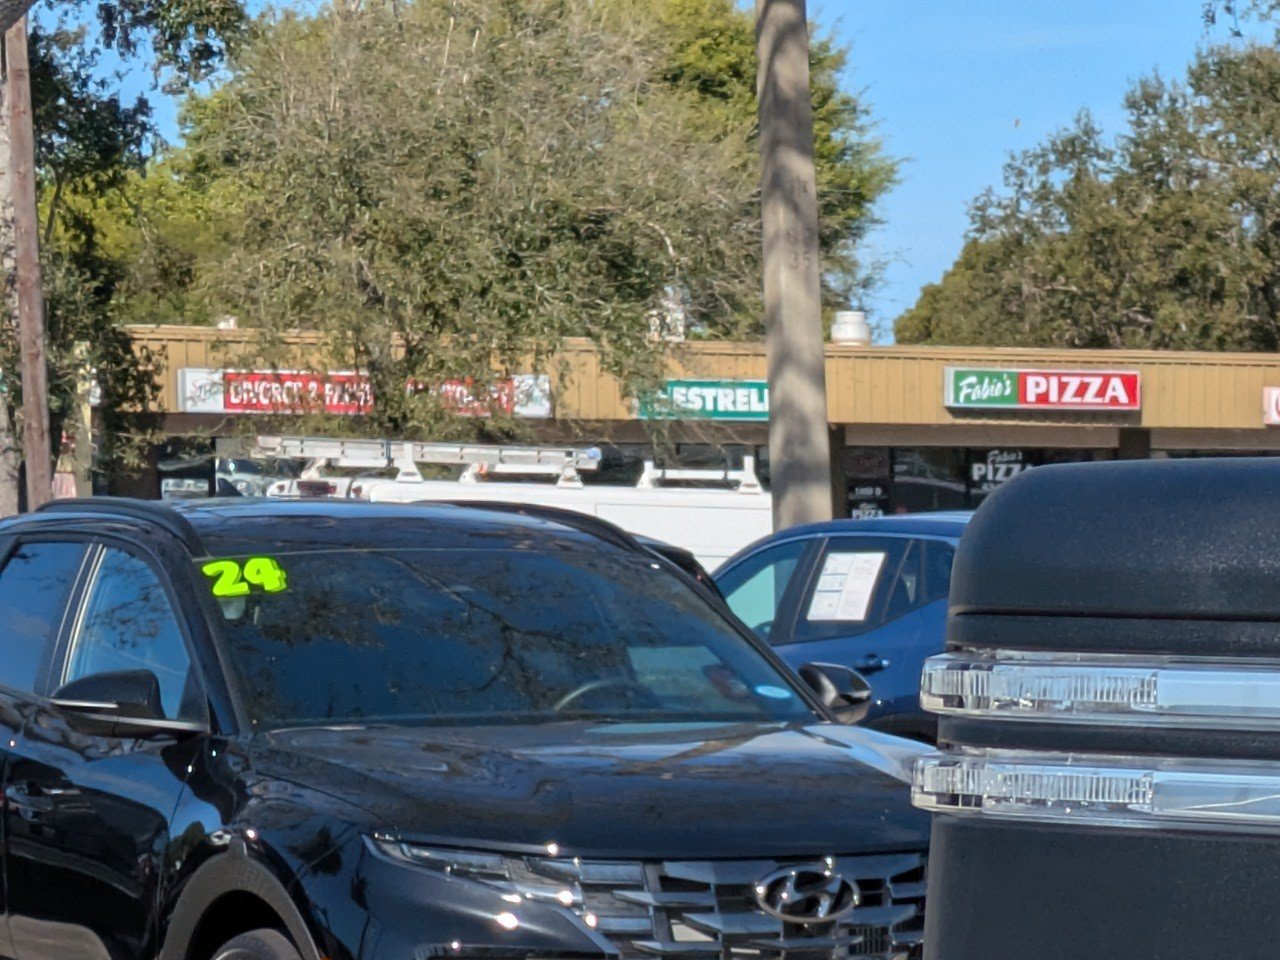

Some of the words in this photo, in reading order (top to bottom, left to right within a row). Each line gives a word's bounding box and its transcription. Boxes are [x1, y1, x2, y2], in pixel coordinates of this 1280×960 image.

[958, 373, 1011, 403] Fabio's
[1026, 376, 1130, 404] PIZZA
[971, 463, 1033, 481] PIZZ
[202, 557, 287, 597] 24
